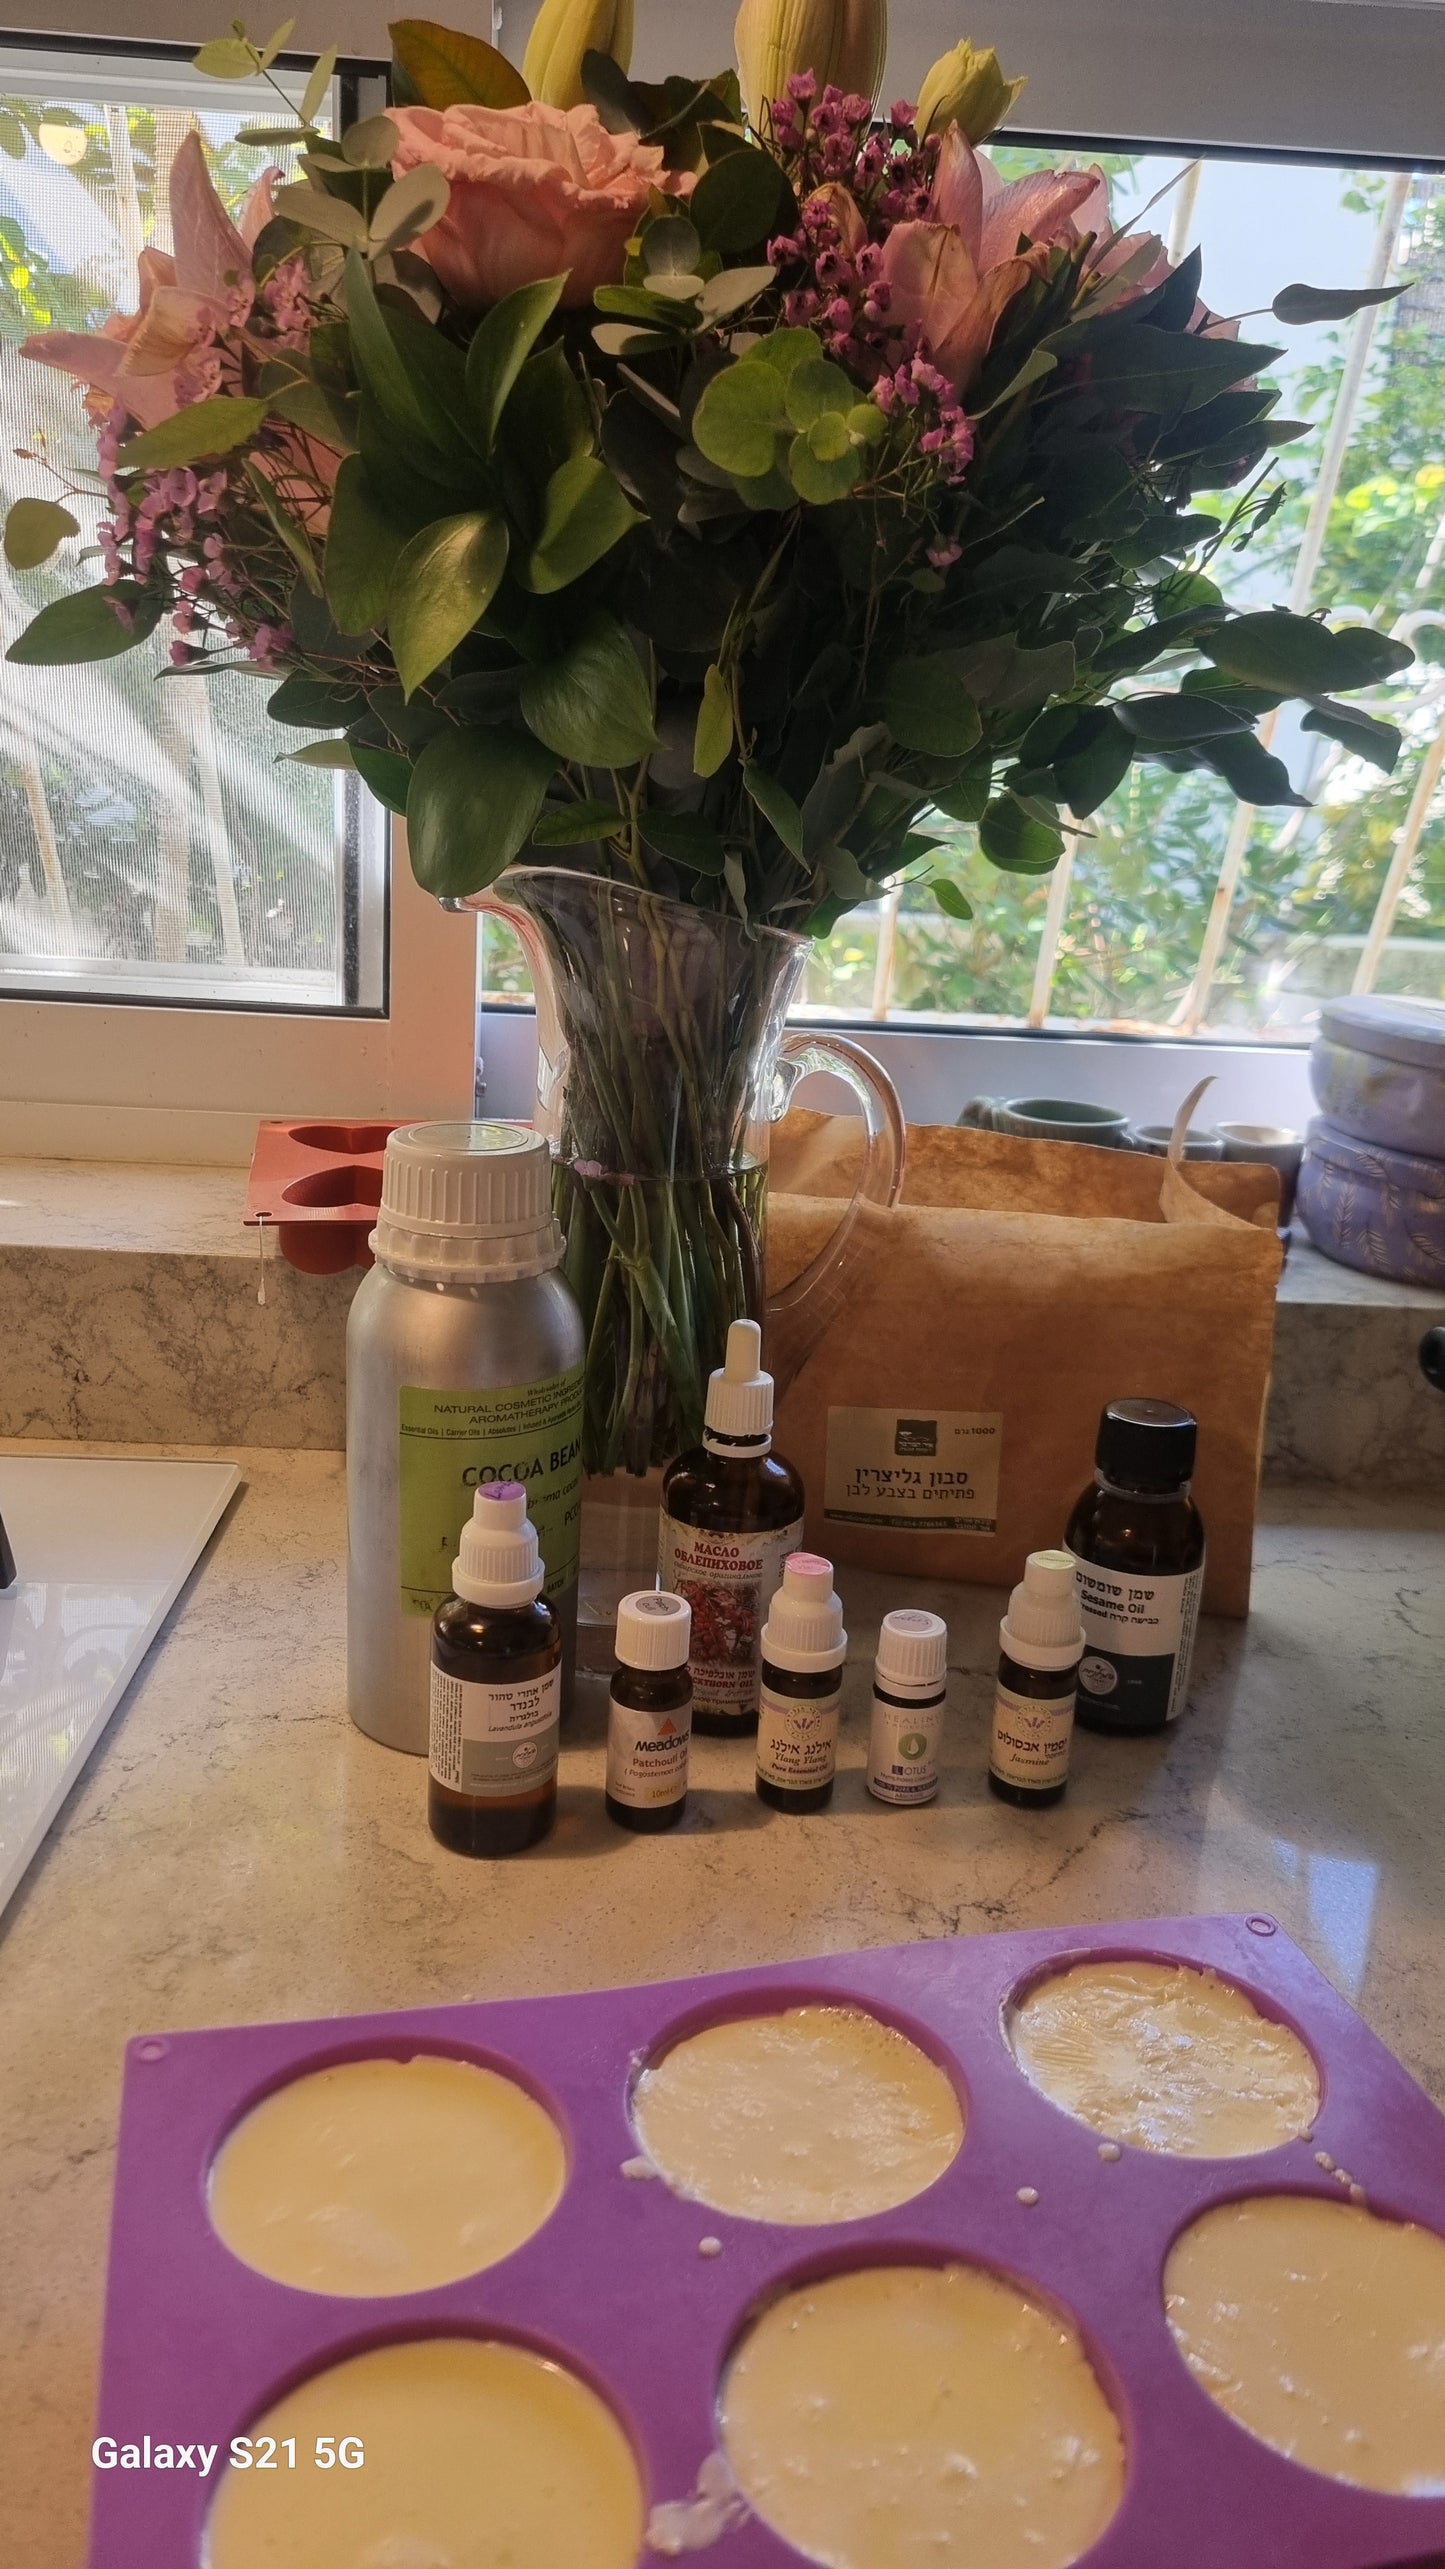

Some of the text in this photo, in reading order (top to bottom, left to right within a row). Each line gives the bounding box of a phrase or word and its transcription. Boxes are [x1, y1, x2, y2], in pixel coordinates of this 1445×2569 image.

[433, 1404, 491, 1414] NATURAL
[495, 1394, 552, 1413] COSMETIC
[468, 1402, 559, 1424] AROMATHERAPY
[401, 1423, 426, 1435] Essential
[427, 1426, 439, 1436] Oils
[971, 1426, 996, 1435] 1000
[462, 1437, 581, 1488] COCOA BEAN
[855, 1467, 969, 1488] סבון גליצרין
[846, 1482, 975, 1500] פתיתים בצבע לבן
[693, 1541, 740, 1558] МАСЛО
[674, 1547, 764, 1571] ОБЛЕПИХОВОЕ
[1075, 1570, 1155, 1602] שמן שומשום
[1080, 1588, 1145, 1615] Sesame Oil
[1080, 1602, 1159, 1625] ressed קרה כבישה
[737, 1669, 755, 1682] שמן
[487, 1679, 555, 1702] שמן אתרי טהור
[509, 1694, 540, 1712] לבנדר
[508, 1710, 539, 1723] בולגריה
[634, 1728, 690, 1753] Meadows
[769, 1738, 832, 1756] אילנג אילנג
[1043, 1736, 1068, 1754] יסמין
[632, 1752, 678, 1768] Patchouli
[775, 1752, 828, 1767] Ylang Ylang
[1009, 1753, 1050, 1766] Jasmine
